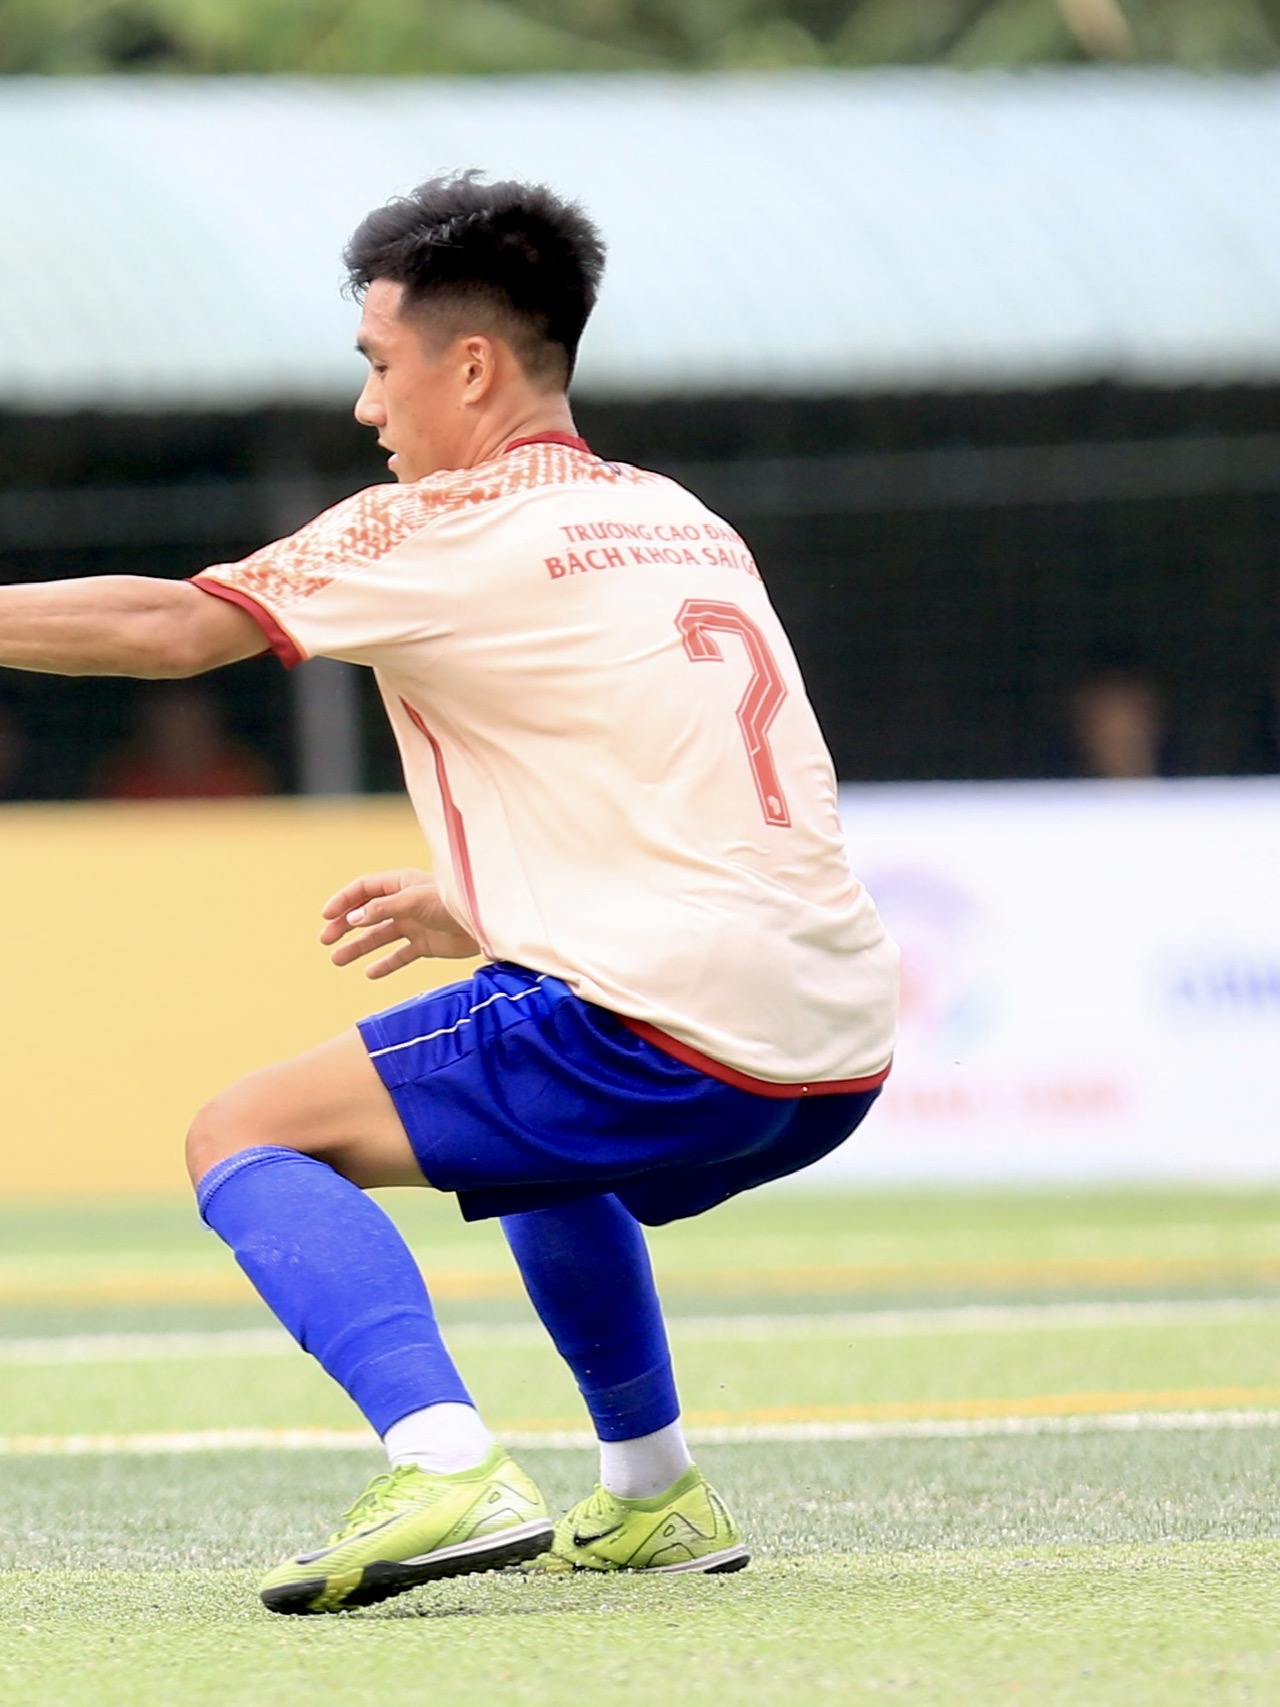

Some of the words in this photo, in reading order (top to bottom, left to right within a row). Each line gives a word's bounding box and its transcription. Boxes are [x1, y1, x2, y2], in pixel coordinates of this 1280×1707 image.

[654, 524, 701, 542] CAO
[544, 546, 626, 580] BÁCH
[627, 546, 702, 566] KHOA
[674, 598, 792, 828] 7
